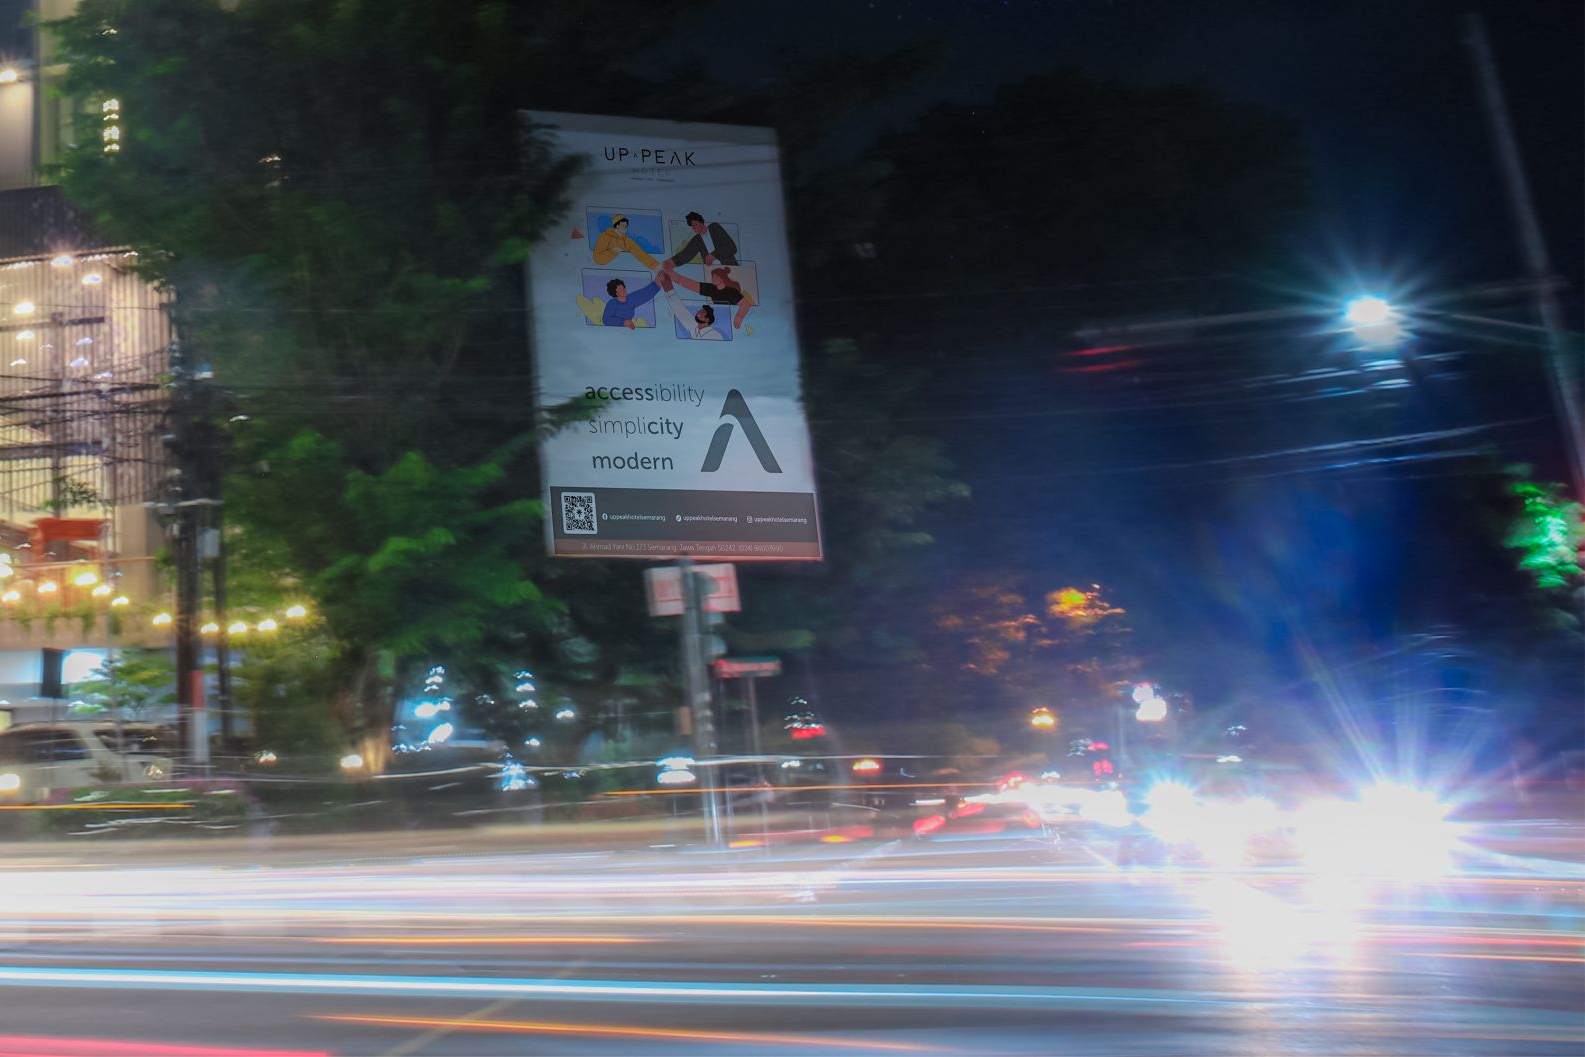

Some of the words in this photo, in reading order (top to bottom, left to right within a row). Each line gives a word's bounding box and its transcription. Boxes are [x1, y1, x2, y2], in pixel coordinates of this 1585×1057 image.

[585, 383, 705, 408] accessibility
[588, 415, 684, 440] simplicity
[592, 451, 674, 471] modern
[609, 513, 666, 522] uppeakhotelsemarang
[683, 514, 738, 523] uppeakhotelsemarang
